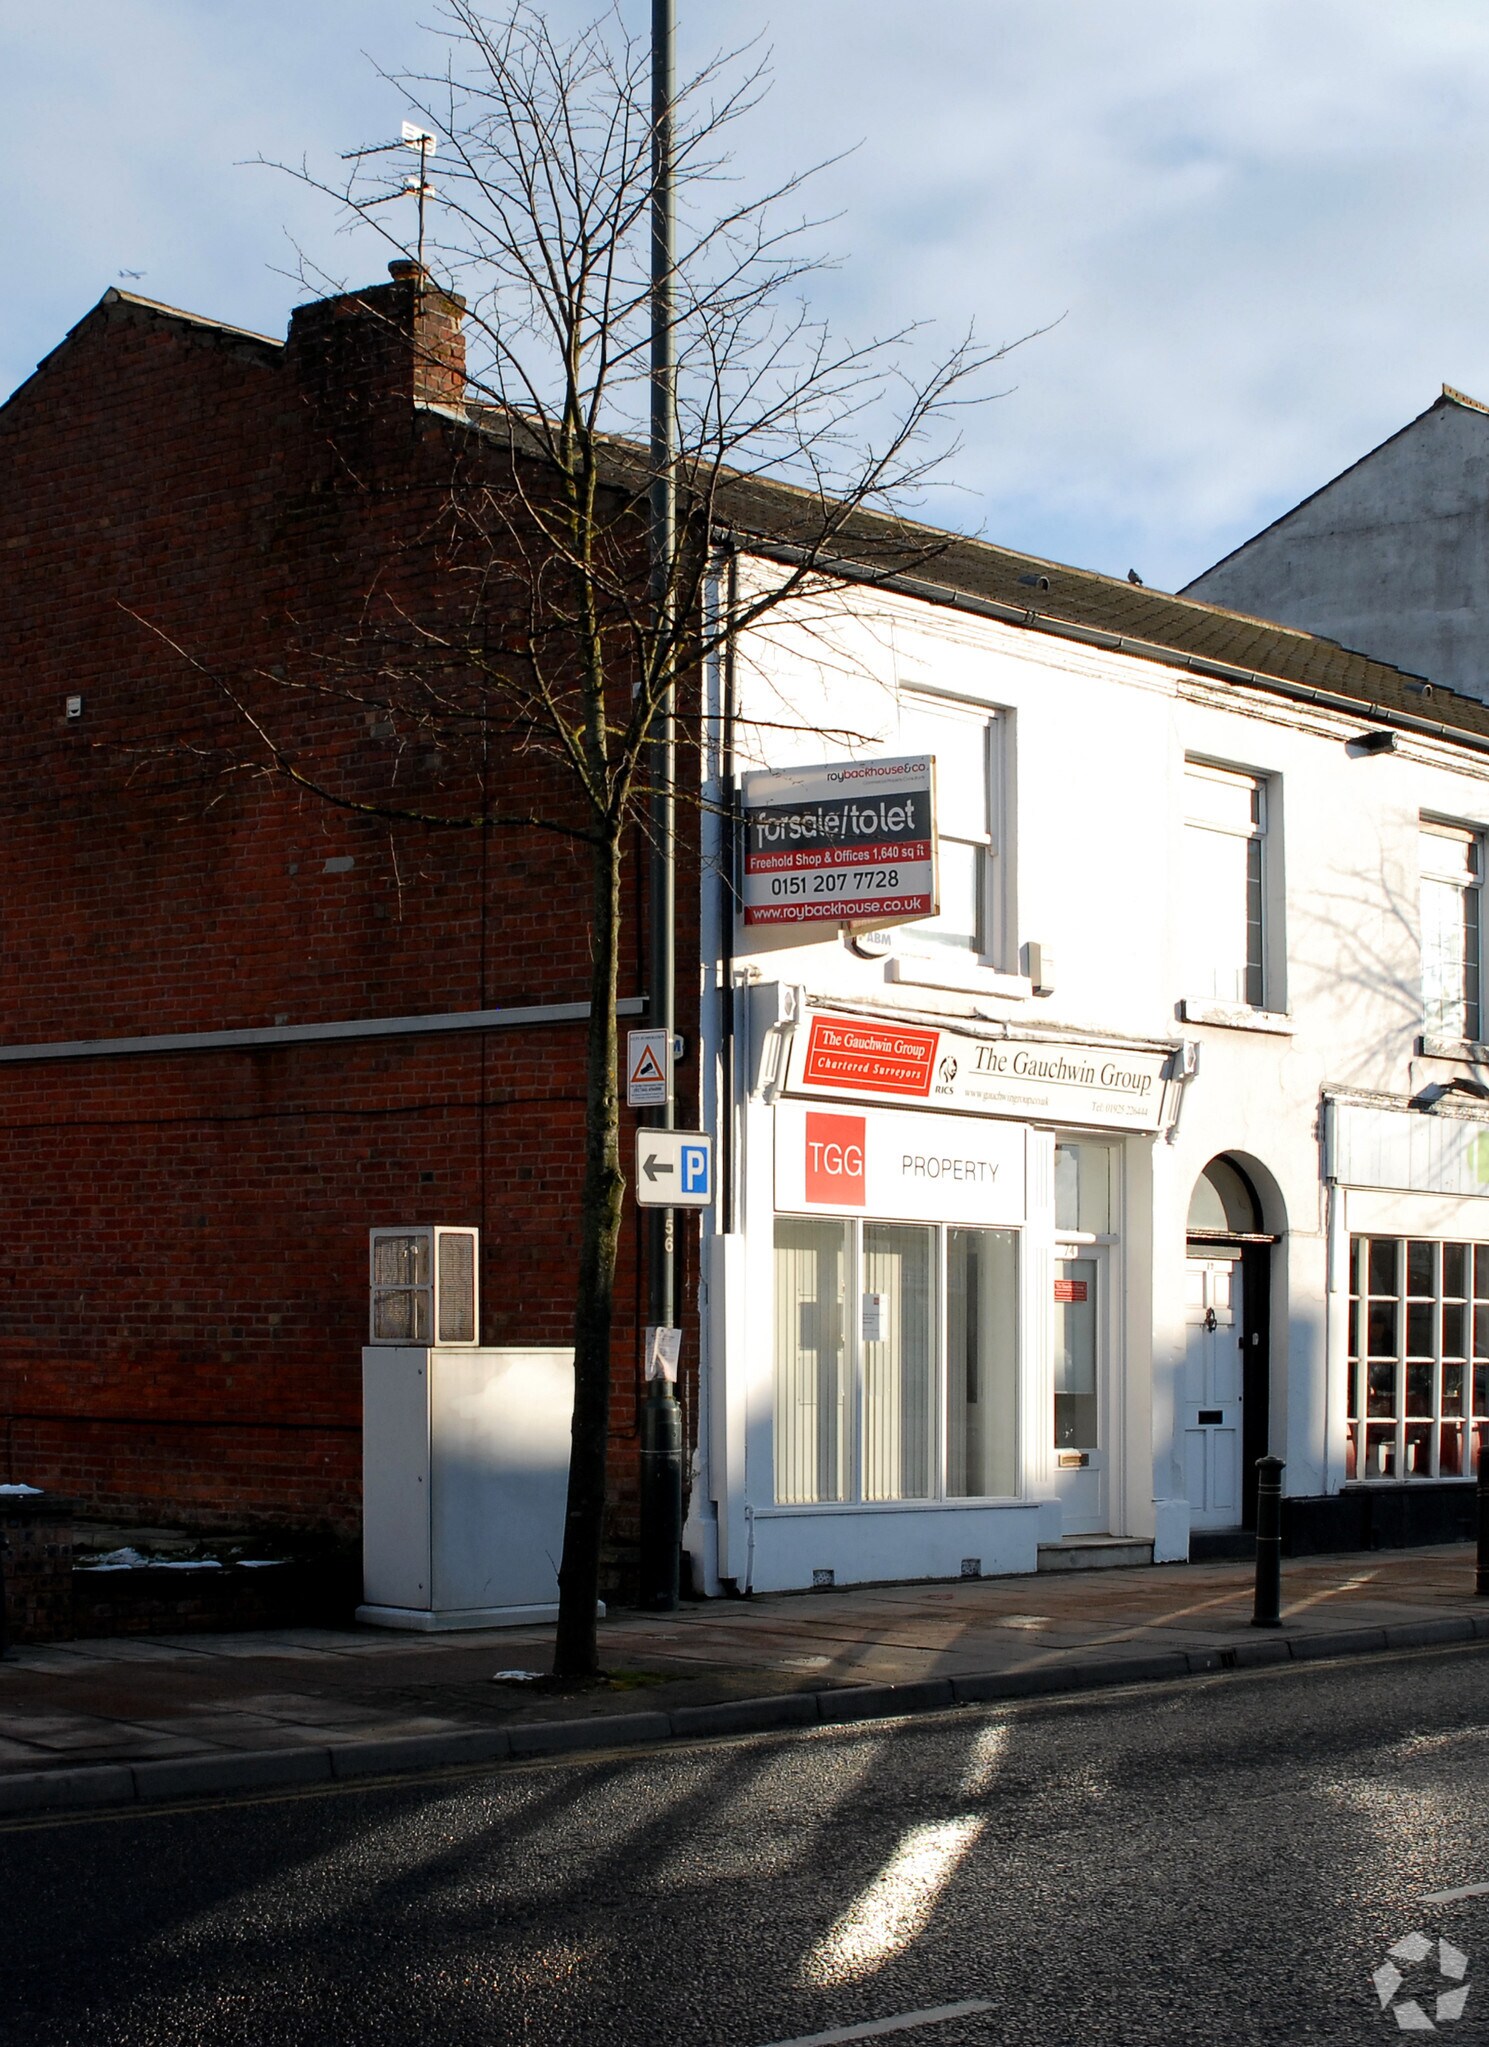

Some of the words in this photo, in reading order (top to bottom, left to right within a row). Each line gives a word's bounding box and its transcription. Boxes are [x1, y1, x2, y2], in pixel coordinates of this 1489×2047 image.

[750, 854, 793, 869] Freehold
[796, 853, 822, 867] Shop
[824, 851, 832, 863] &
[834, 849, 870, 863] Offices
[872, 847, 899, 861] 1,640
[901, 848, 915, 859] sq
[916, 844, 925, 856] ft
[771, 876, 806, 896] 0151
[813, 874, 848, 893] 207
[853, 869, 899, 890] 7728
[753, 896, 922, 921] www.roybackhouse.co.uk
[867, 932, 891, 946] ABM
[822, 1029, 842, 1047] The
[844, 1033, 892, 1054] Gauchwin
[894, 1039, 926, 1061] Group
[817, 1056, 870, 1074] Chartered
[872, 1063, 921, 1080] Surveyors
[974, 1045, 1008, 1072] The
[1013, 1050, 1096, 1085] Gauchwin
[1100, 1062, 1152, 1097] Group
[935, 1085, 954, 1096] RICS
[686, 1149, 706, 1191] P
[808, 1141, 863, 1177] TGG
[902, 1154, 1000, 1183] PROPERTY
[664, 1218, 674, 1253] 56
